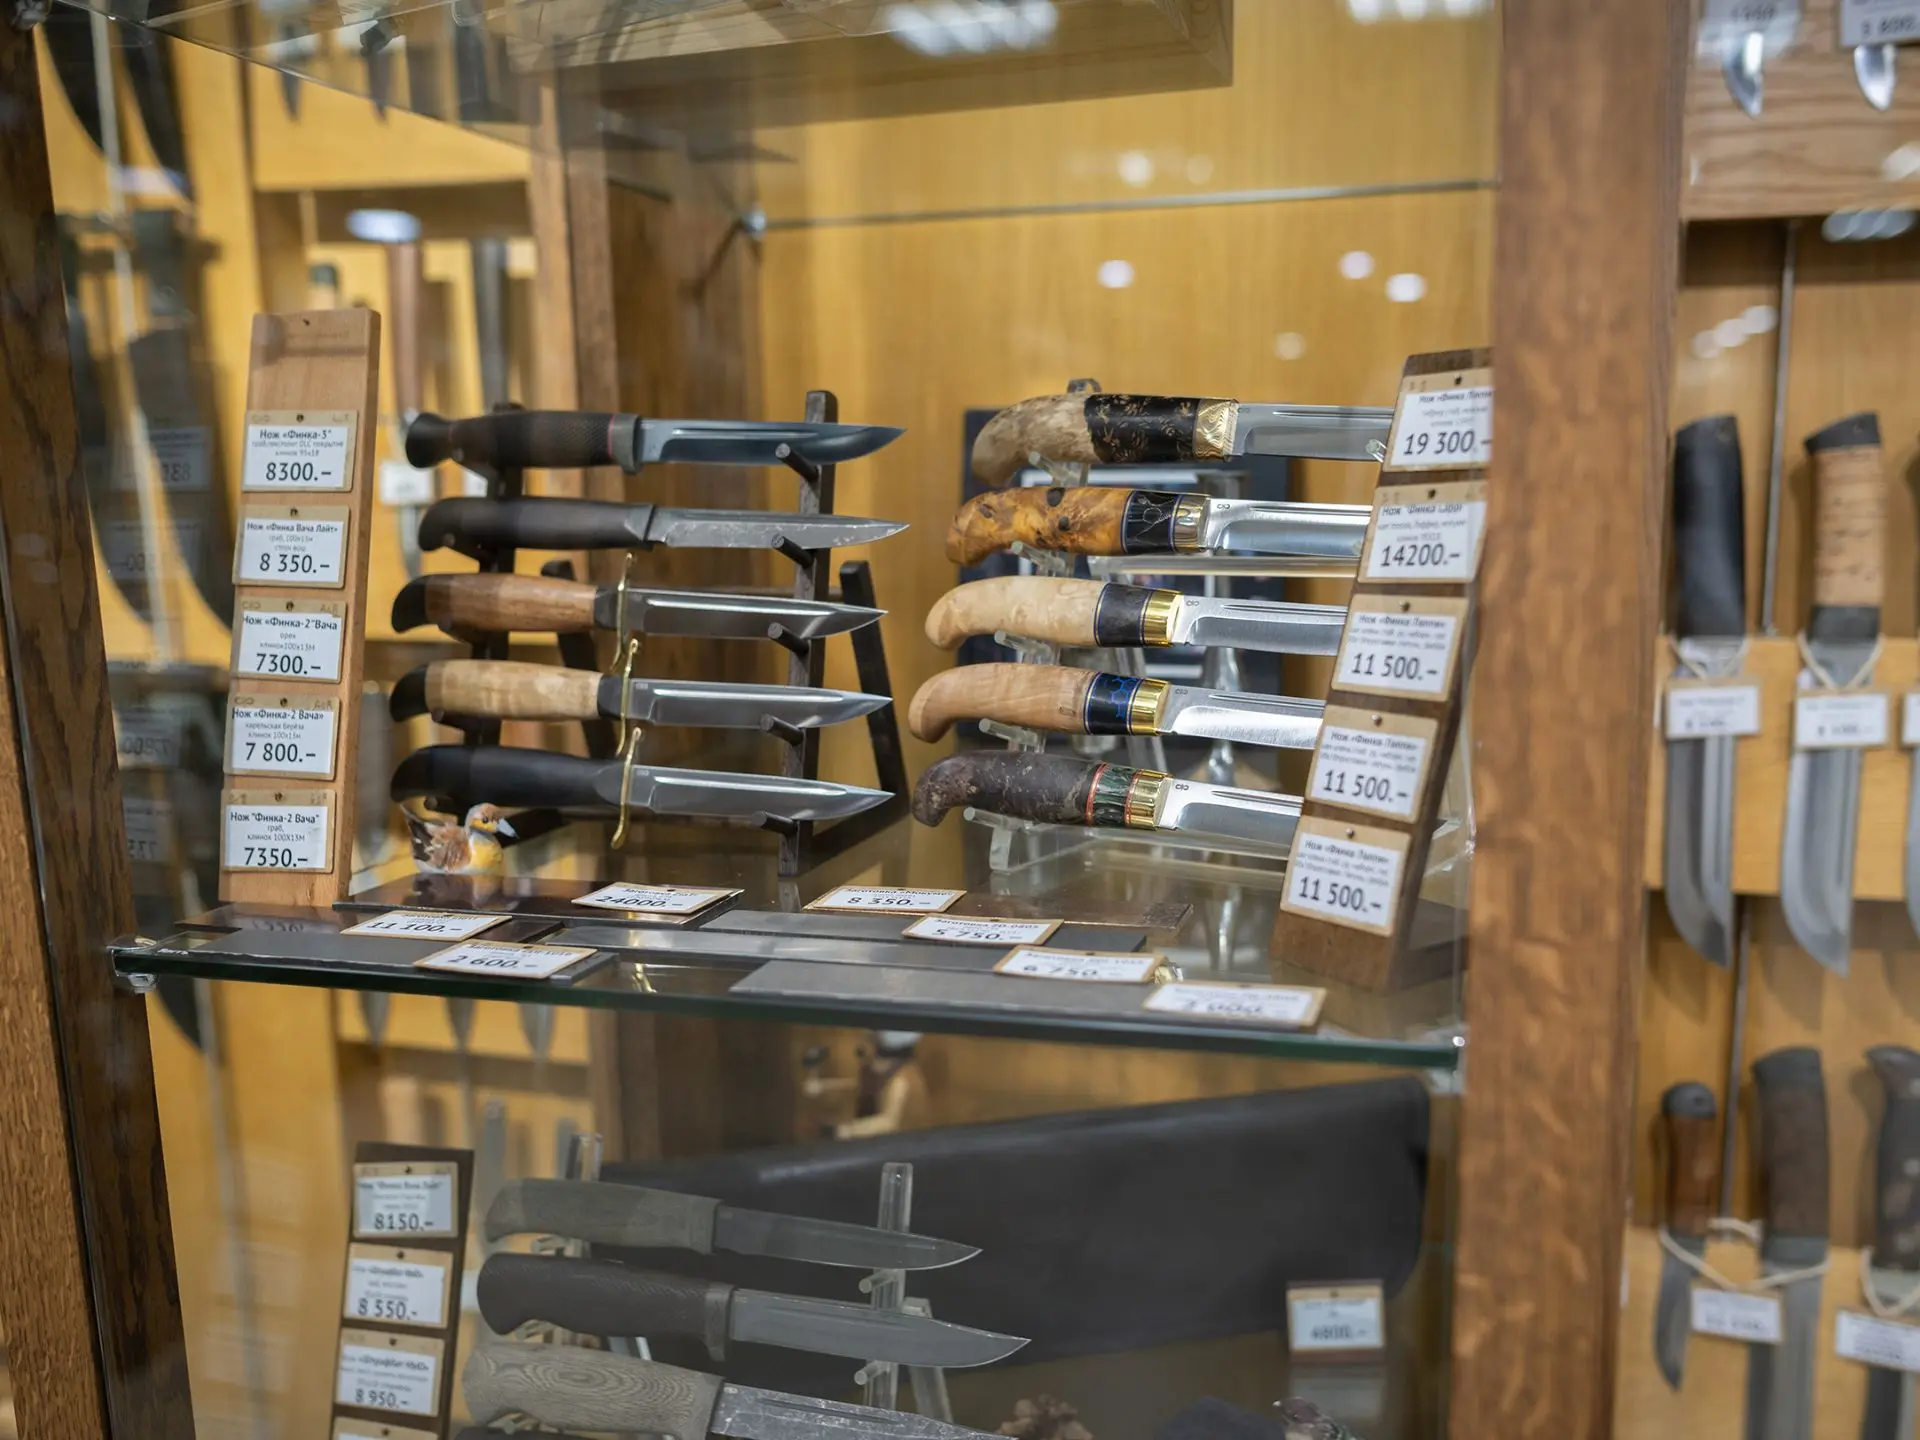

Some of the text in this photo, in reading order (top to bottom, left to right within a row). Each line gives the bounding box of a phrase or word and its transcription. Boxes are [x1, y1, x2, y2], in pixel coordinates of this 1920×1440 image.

[260, 429, 279, 439] Нож
[1403, 433, 1429, 455] 19
[266, 462, 331, 481] 8300.-
[247, 523, 263, 531] Нож
[260, 553, 270, 571] 8
[256, 653, 320, 674] 7300.-
[1352, 653, 1375, 675] 11
[232, 708, 251, 719] Нож
[245, 743, 256, 760] 7
[1323, 770, 1345, 794] 11
[230, 812, 249, 821] Нож
[244, 847, 308, 867] 7350.-
[1299, 876, 1320, 901] 11
[366, 921, 398, 929] 11
[447, 955, 468, 963] 2
